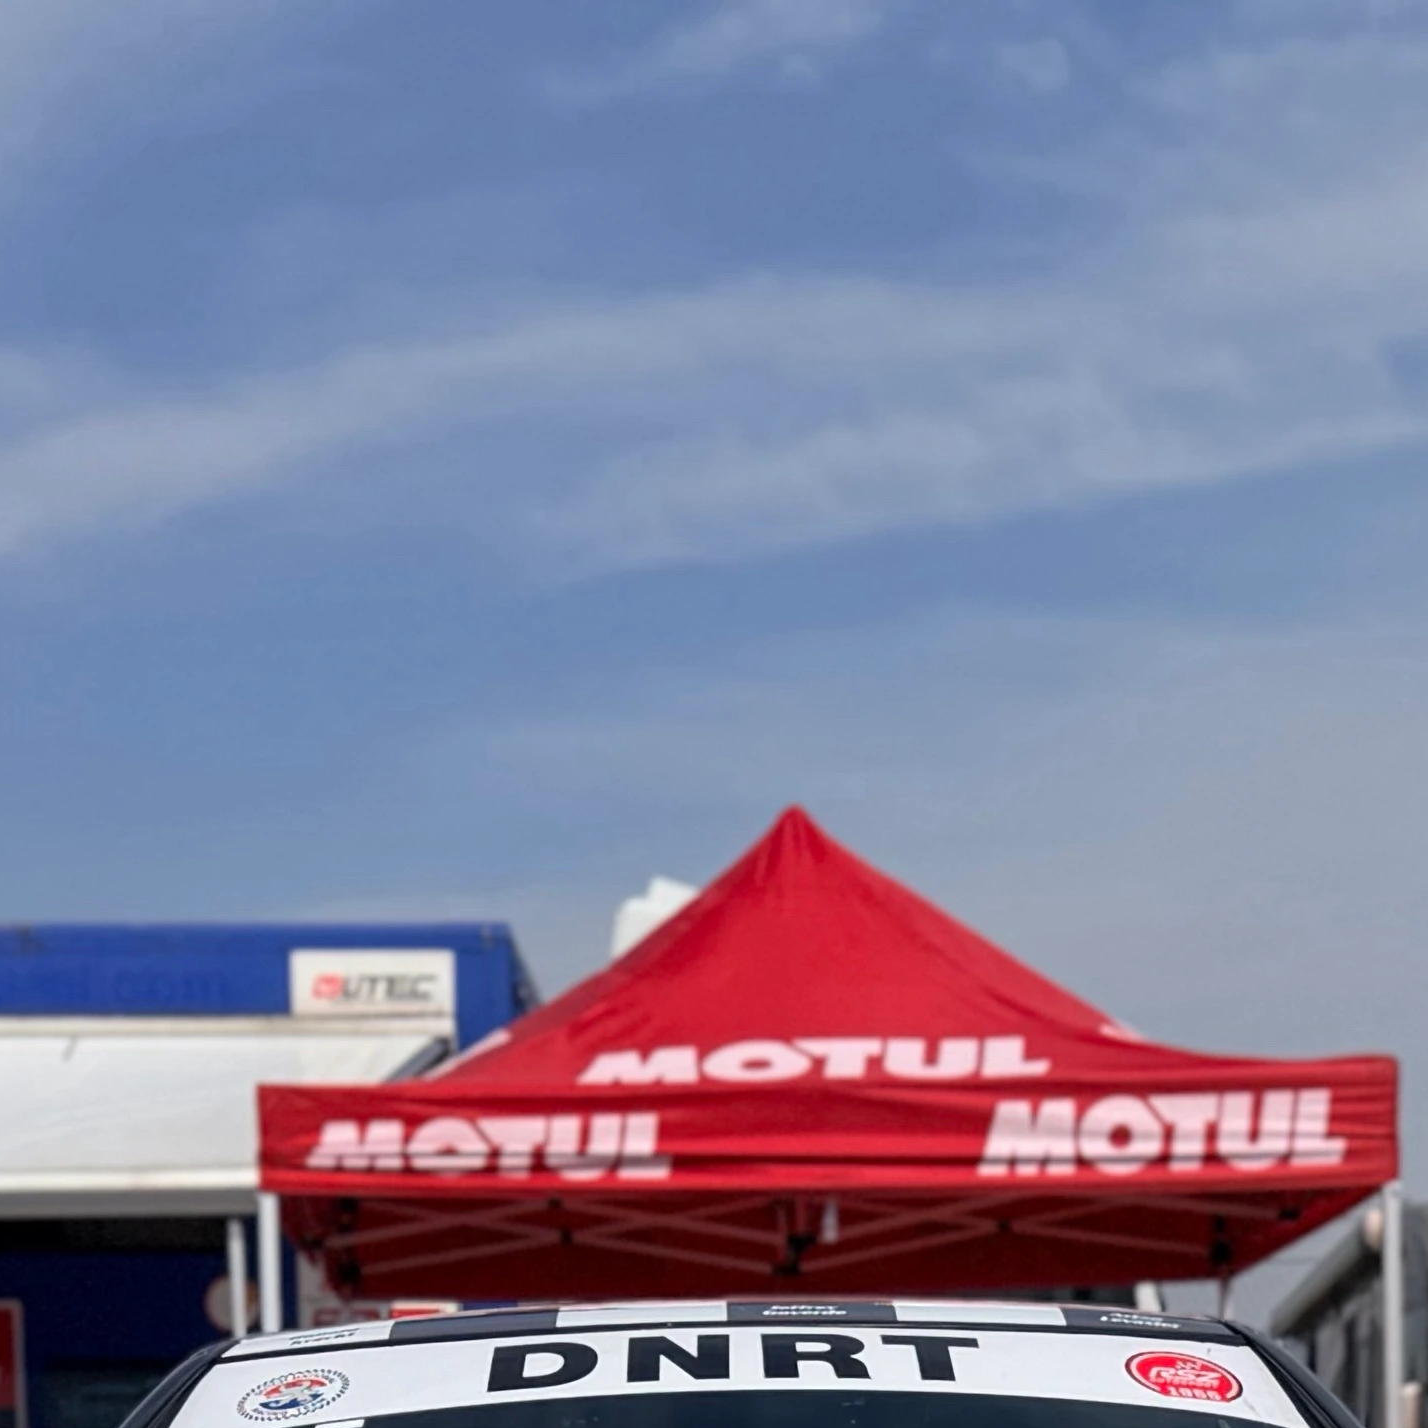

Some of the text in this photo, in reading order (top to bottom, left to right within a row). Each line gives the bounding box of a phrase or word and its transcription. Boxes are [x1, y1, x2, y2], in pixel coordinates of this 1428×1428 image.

[578, 1036, 1052, 1085] MOTUL
[304, 1112, 672, 1181] MOTUL
[976, 1089, 1345, 1178] MOTUL
[486, 1333, 980, 1393] DNRT
